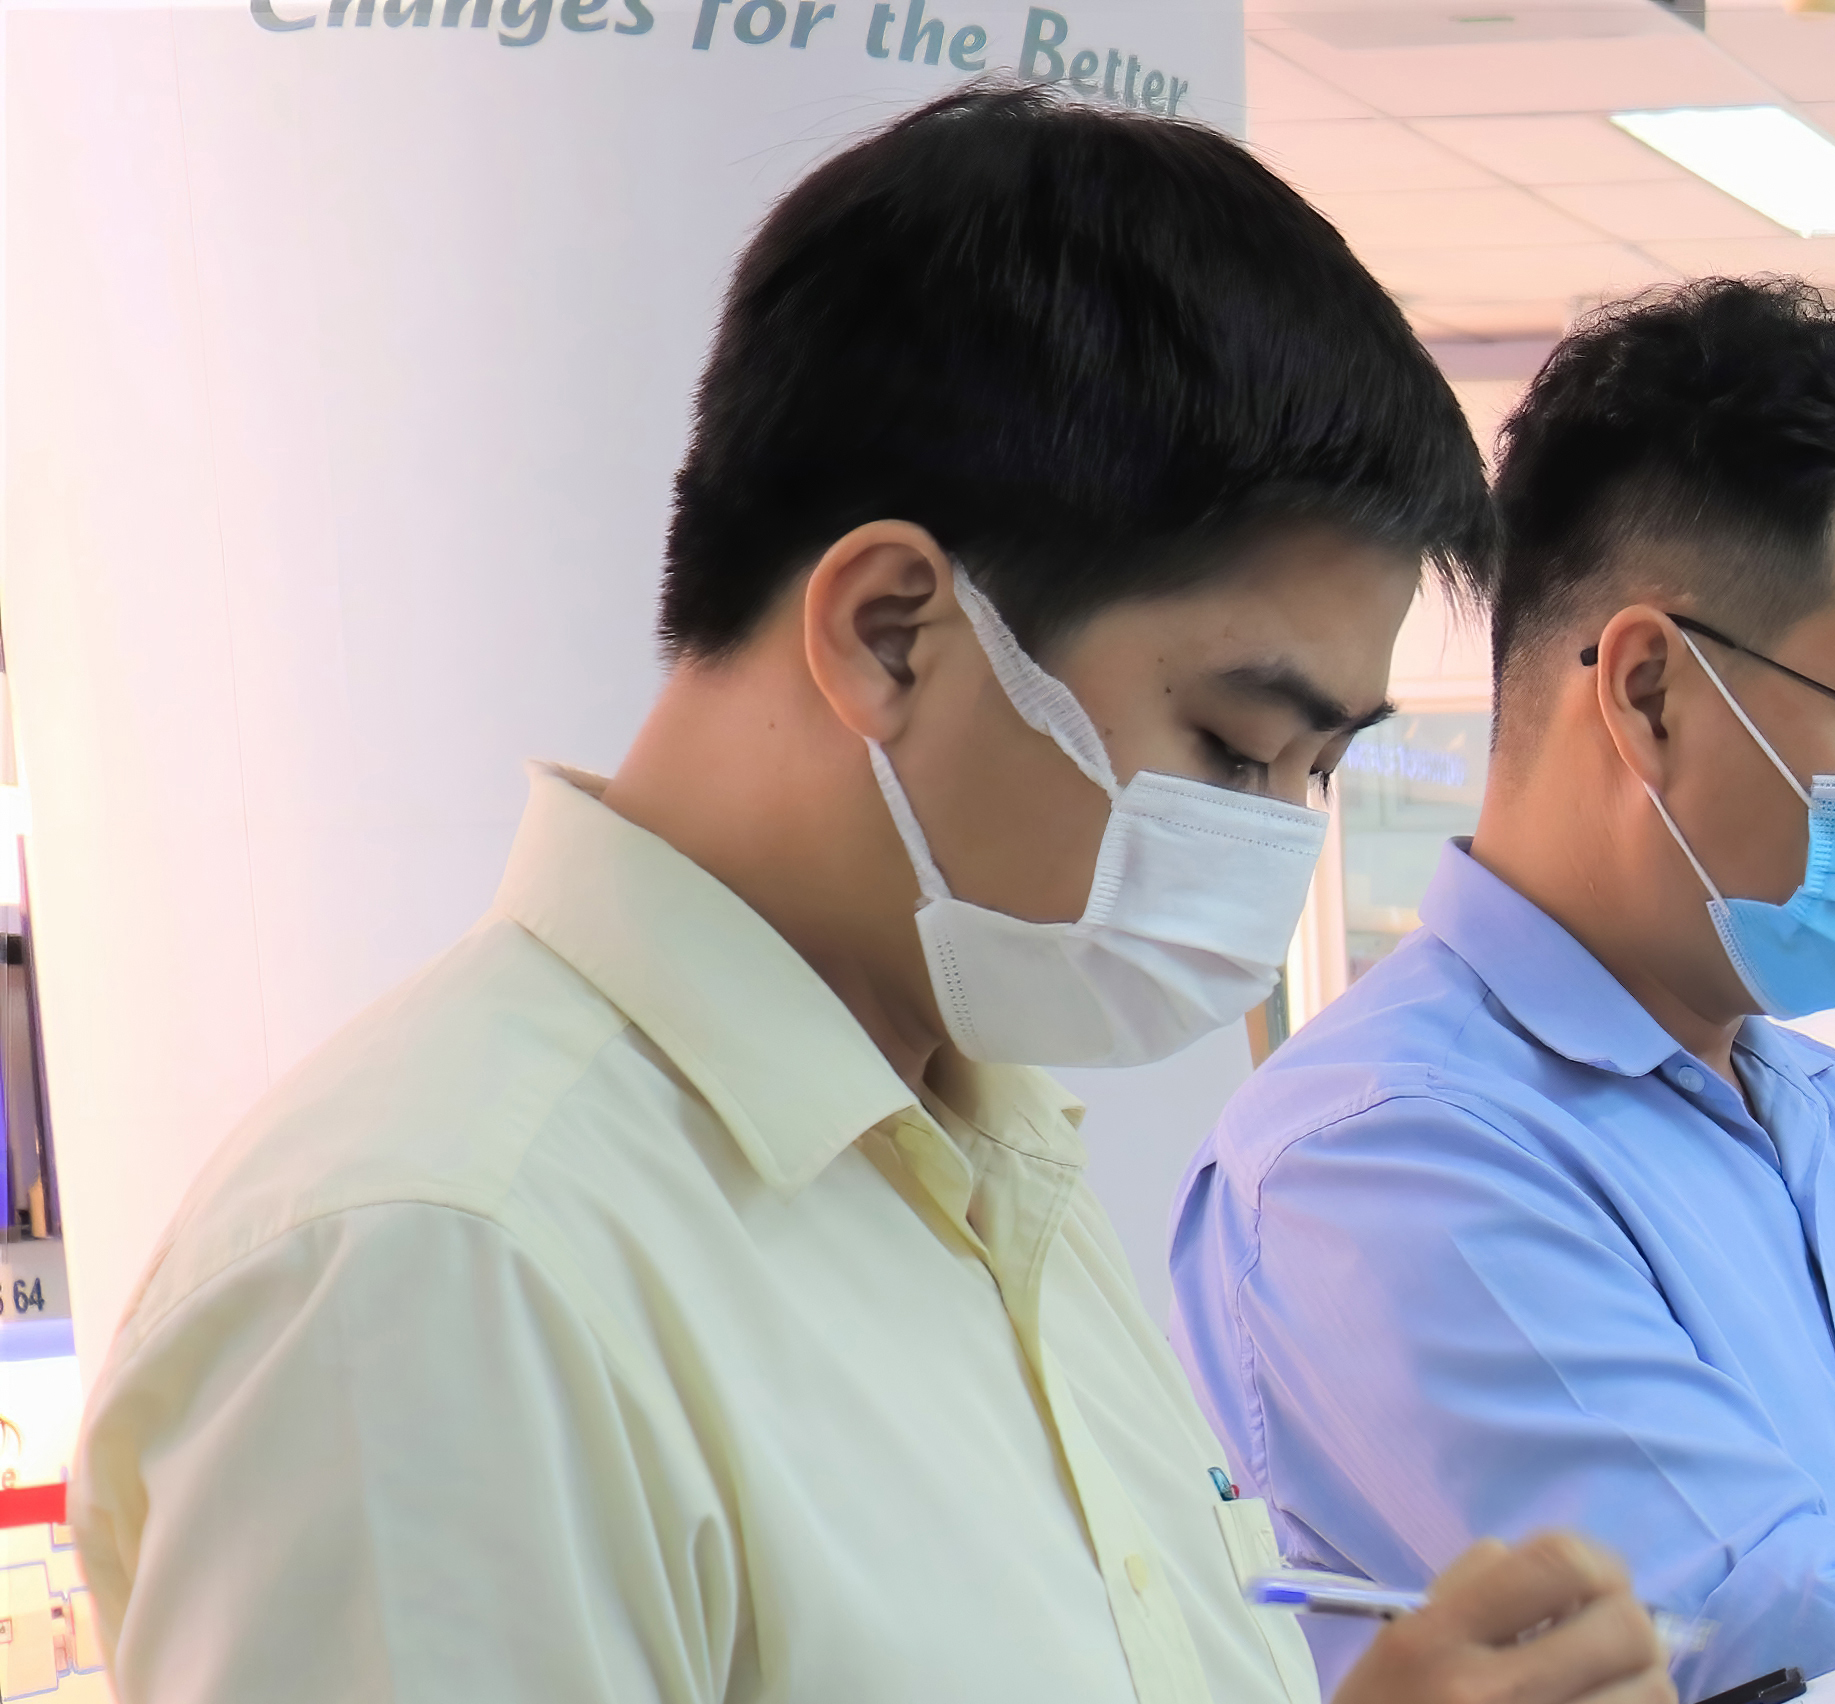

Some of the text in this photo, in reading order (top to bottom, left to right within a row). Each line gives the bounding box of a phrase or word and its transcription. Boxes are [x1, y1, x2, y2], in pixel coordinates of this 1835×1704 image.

[691, 0, 835, 51] for
[866, 0, 986, 72] the
[1018, 6, 1188, 118] Better
[13, 1277, 45, 1314] 64
